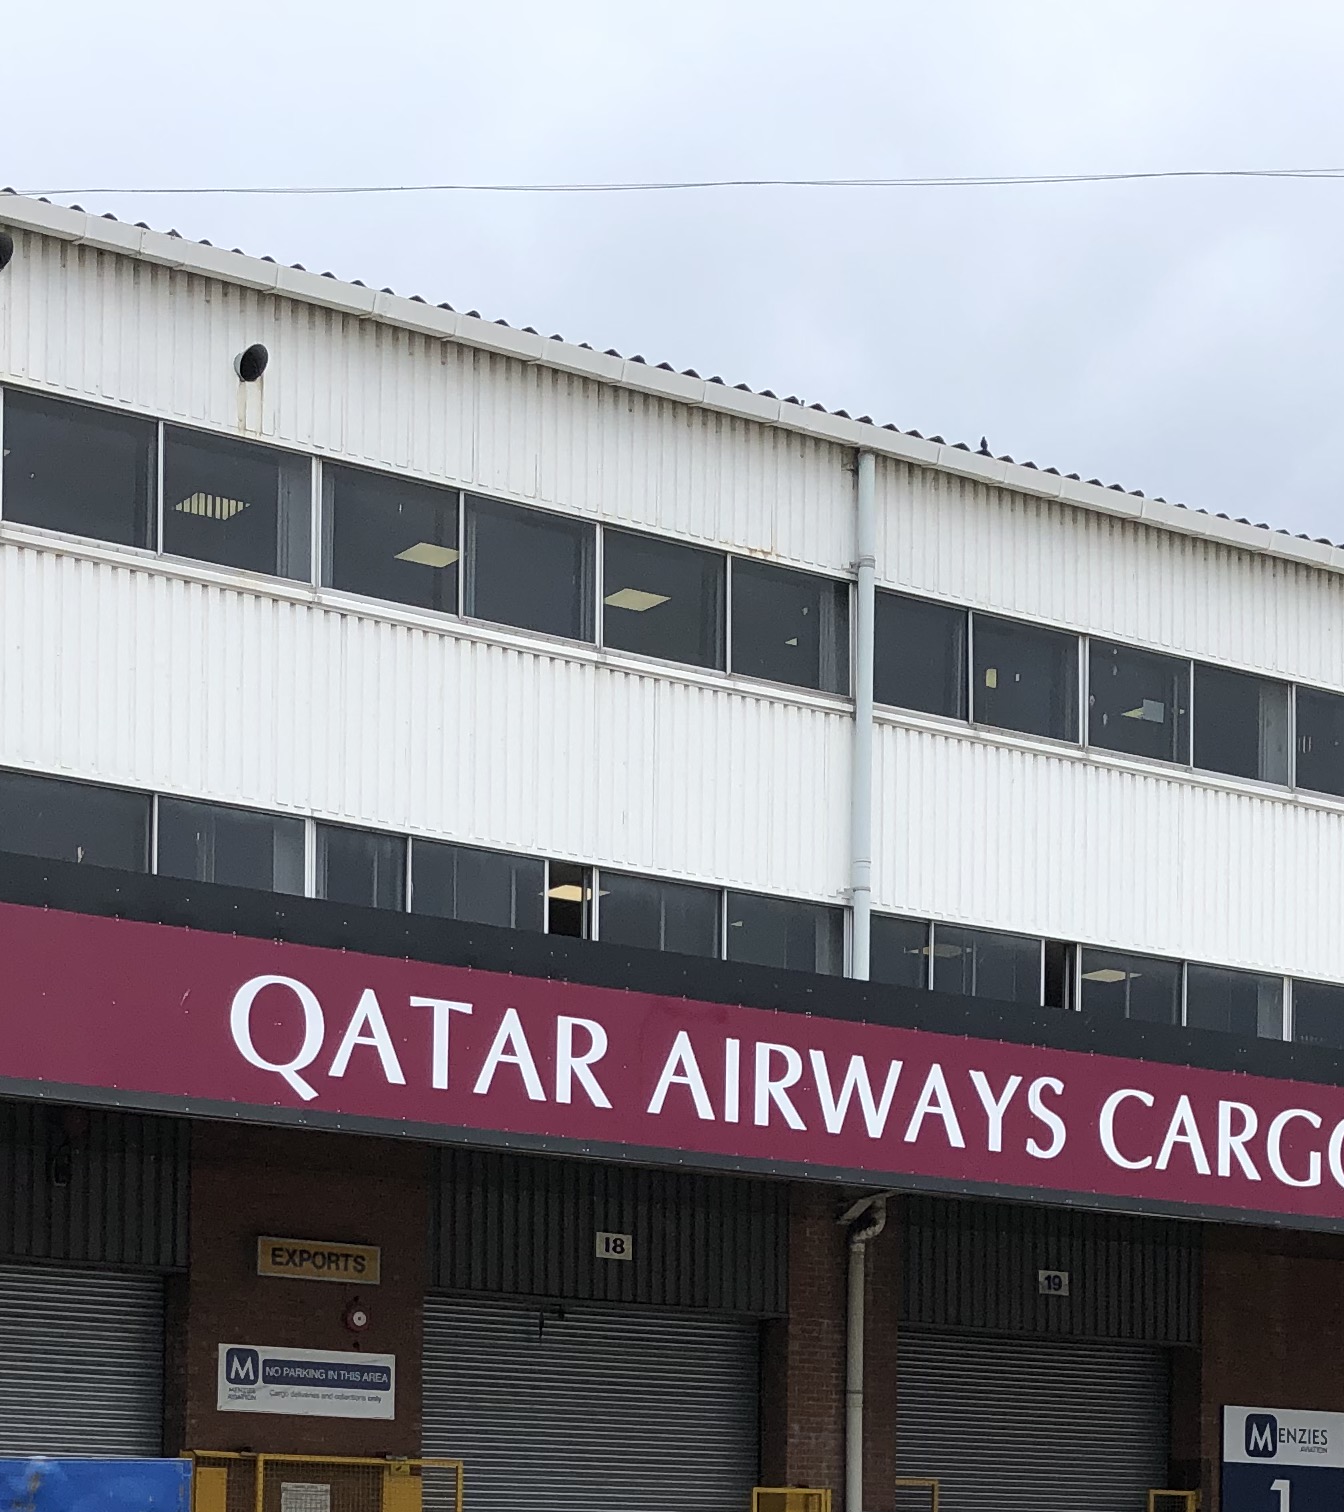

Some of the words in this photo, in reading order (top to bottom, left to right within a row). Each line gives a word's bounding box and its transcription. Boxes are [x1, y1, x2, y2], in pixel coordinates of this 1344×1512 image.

[231, 974, 613, 1109] QATAR
[646, 1030, 1067, 1160] AIRWAYS
[604, 1236, 626, 1255] 18
[271, 1246, 366, 1274] EXPORTS
[1044, 1274, 1063, 1292] 19
[265, 1366, 281, 1377] NO
[283, 1368, 326, 1380] PARKING
[327, 1370, 338, 1380] IN
[340, 1371, 361, 1382] THIS
[362, 1373, 389, 1383] AREA
[1248, 1421, 1329, 1452] MENZIES
